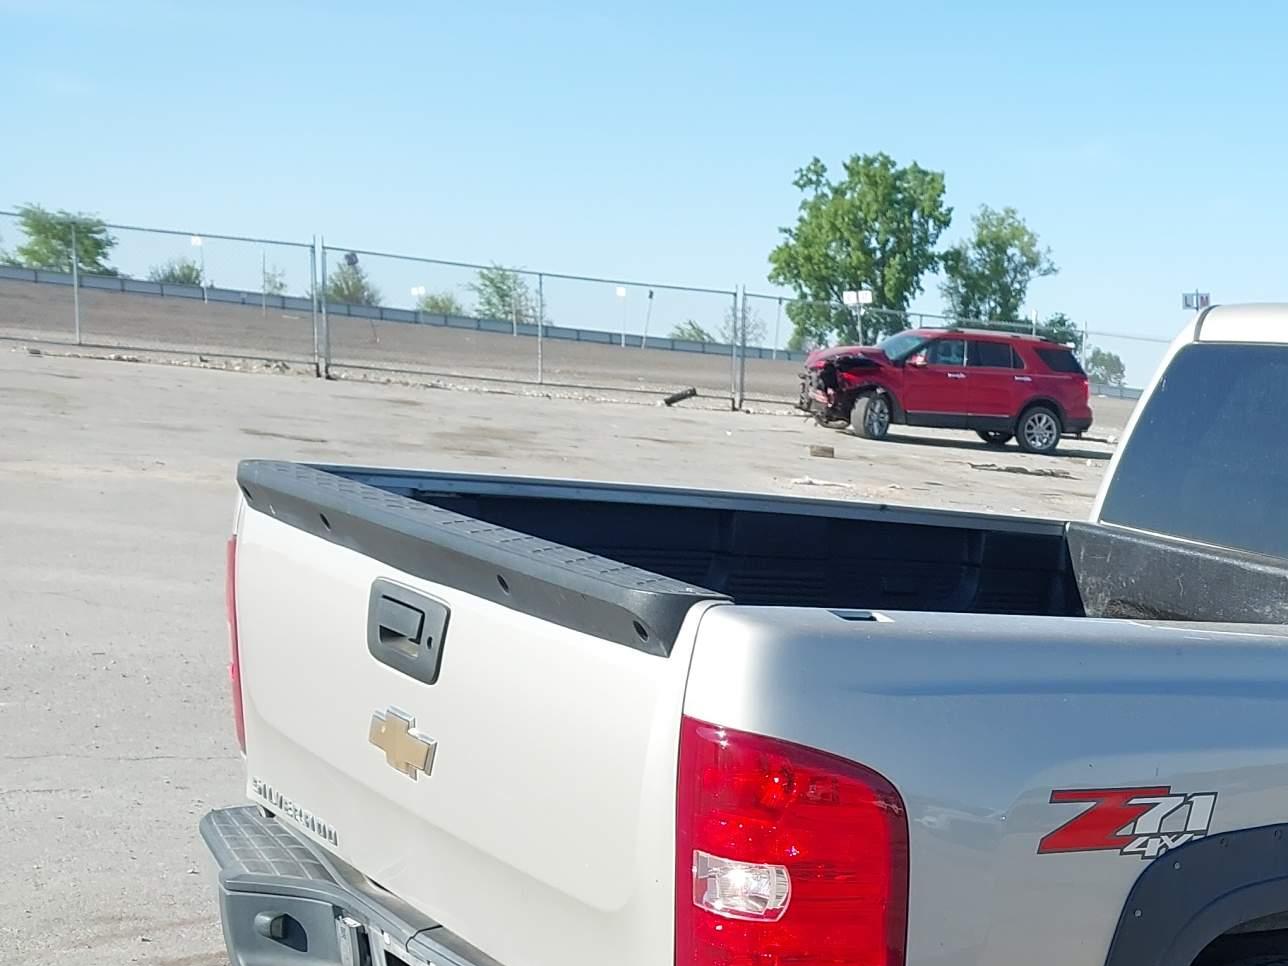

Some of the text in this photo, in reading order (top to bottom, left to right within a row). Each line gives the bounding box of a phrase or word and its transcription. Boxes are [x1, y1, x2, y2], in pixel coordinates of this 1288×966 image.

[252, 776, 338, 847] SILVERADO
[1037, 786, 1218, 855] Z71
[1119, 832, 1195, 859] 4X
